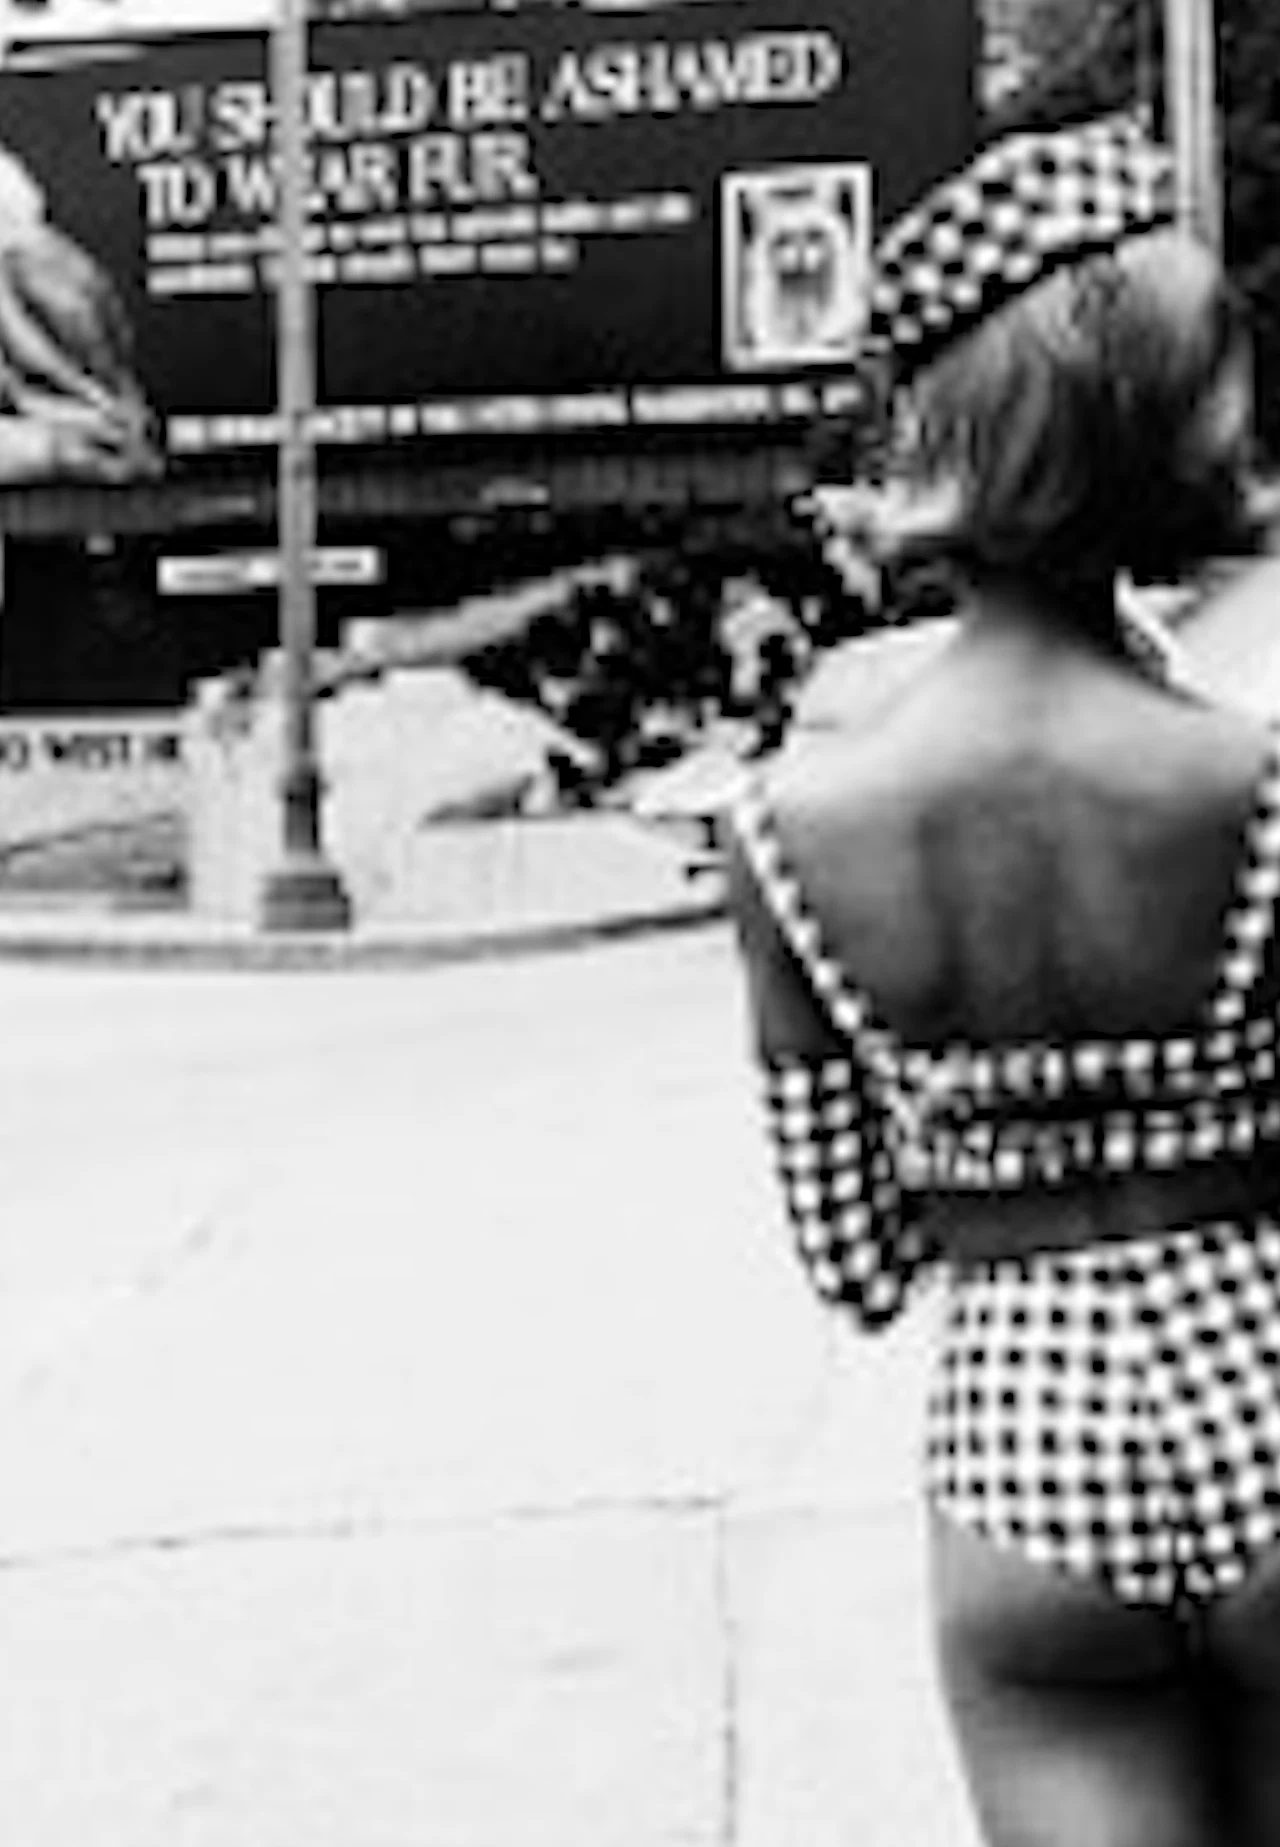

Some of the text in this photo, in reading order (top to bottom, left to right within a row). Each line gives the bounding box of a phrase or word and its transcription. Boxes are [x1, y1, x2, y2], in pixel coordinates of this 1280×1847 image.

[97, 86, 200, 158] YOU
[213, 65, 431, 151] SHULD
[542, 33, 840, 119] ASHAMED
[136, 160, 215, 225] TO
[226, 141, 399, 214] WAR
